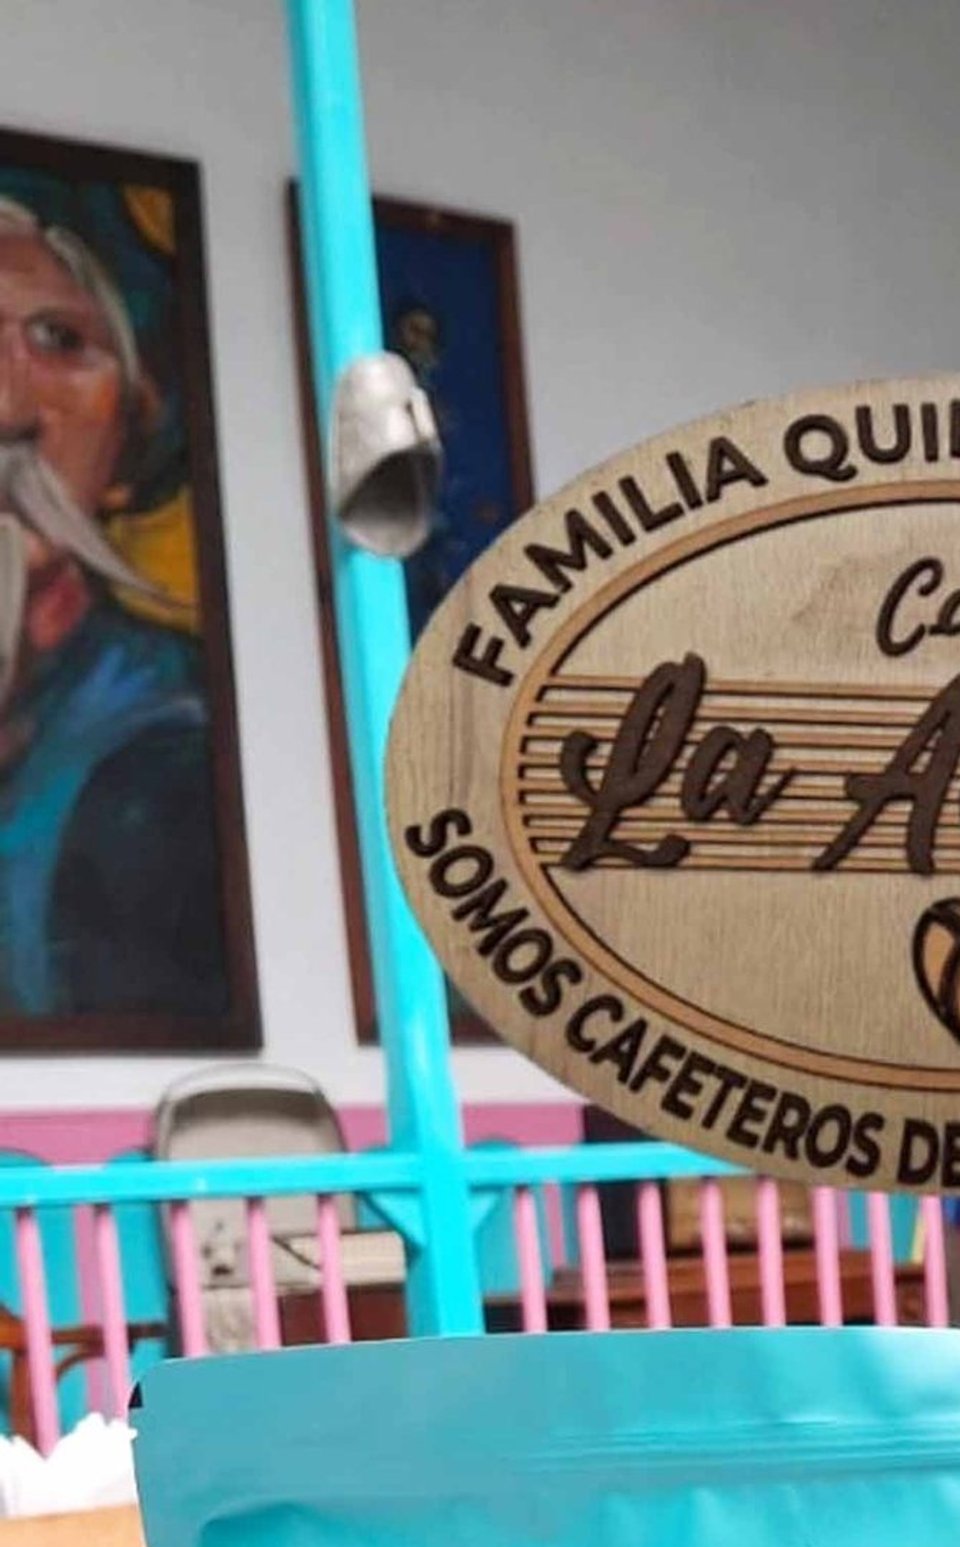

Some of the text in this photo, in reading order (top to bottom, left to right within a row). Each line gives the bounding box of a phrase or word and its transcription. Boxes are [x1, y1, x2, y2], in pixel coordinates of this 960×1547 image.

[453, 437, 767, 687] FAMILIA
[560, 652, 796, 873] La
[405, 807, 583, 1018] SOMOS
[564, 998, 885, 1178] CAFETEROS
